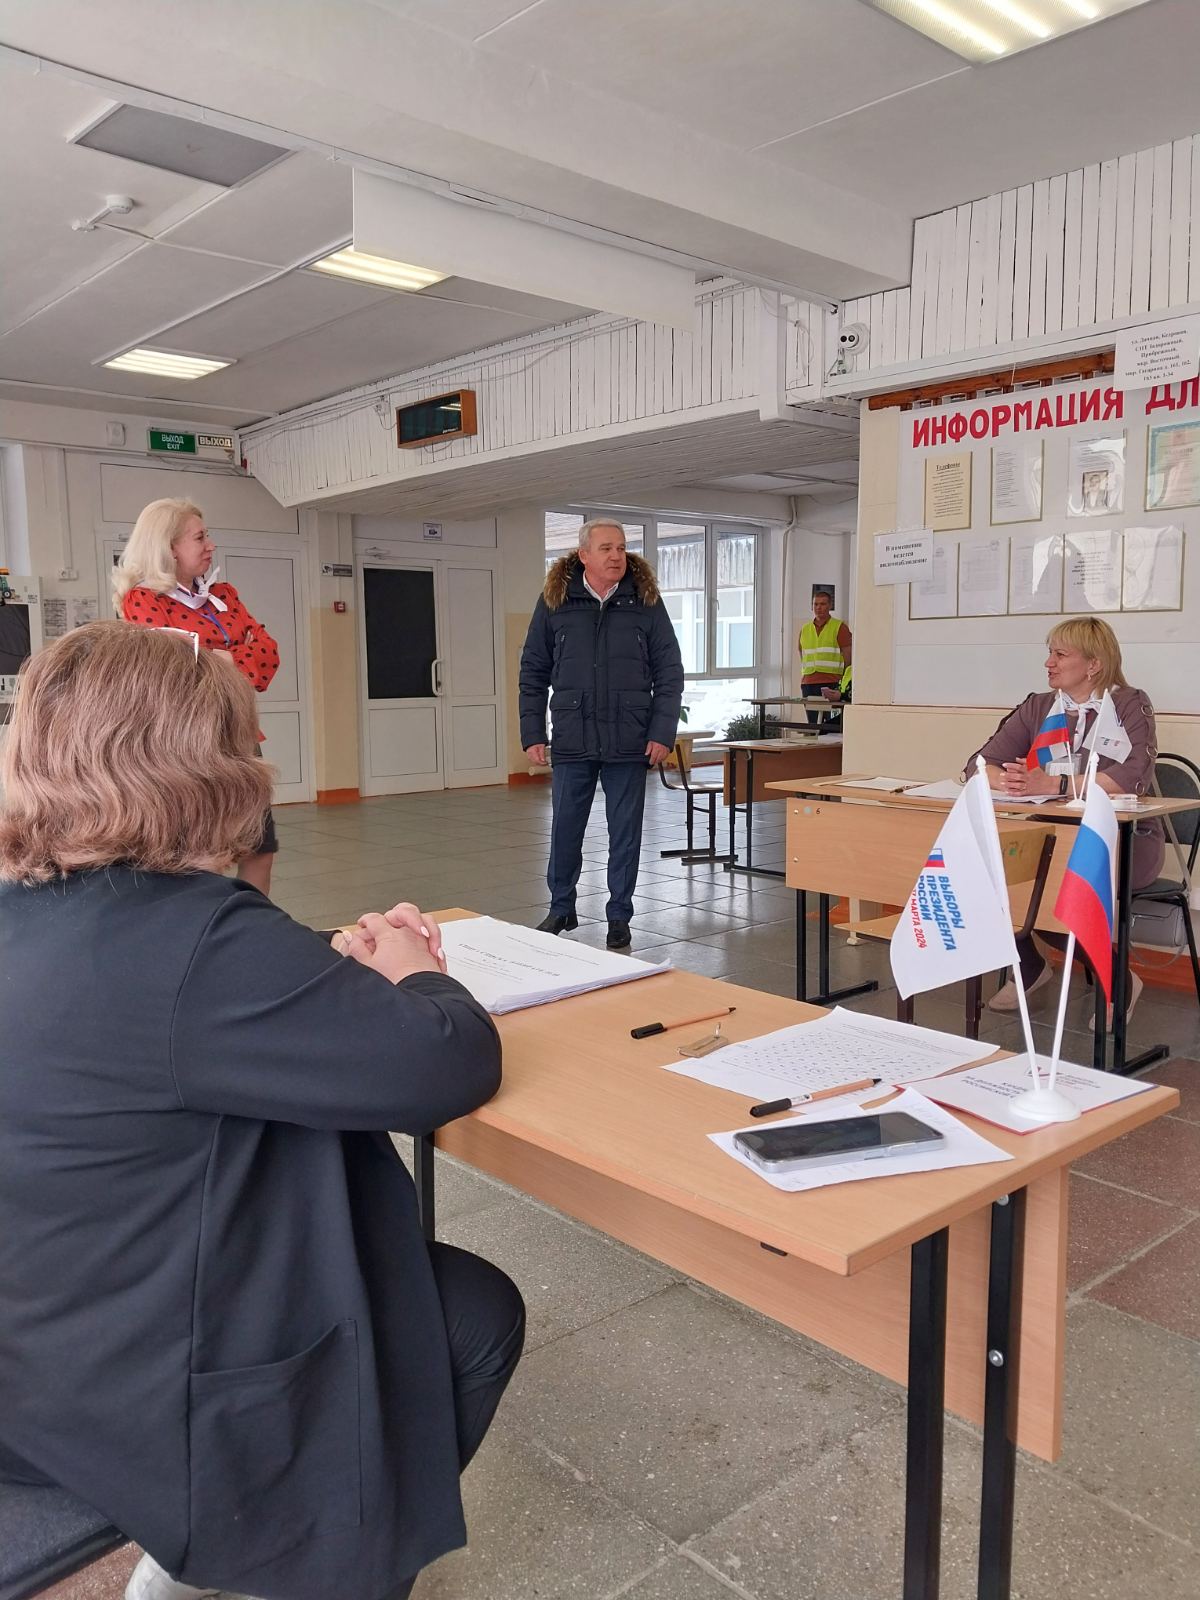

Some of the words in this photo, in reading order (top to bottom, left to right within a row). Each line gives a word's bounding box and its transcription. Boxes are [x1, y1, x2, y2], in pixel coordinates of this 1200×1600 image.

[912, 387, 1124, 448] ИНФОРМАЦИЯ
[161, 434, 185, 444] ВЫХОД
[199, 436, 232, 447] ВЫХОД
[911, 899, 921, 926] МАРТА
[926, 875, 957, 950] ПРЕЗИДЕНТА
[938, 875, 965, 929] ВЫБОРЫ
[914, 928, 928, 949] 2024
